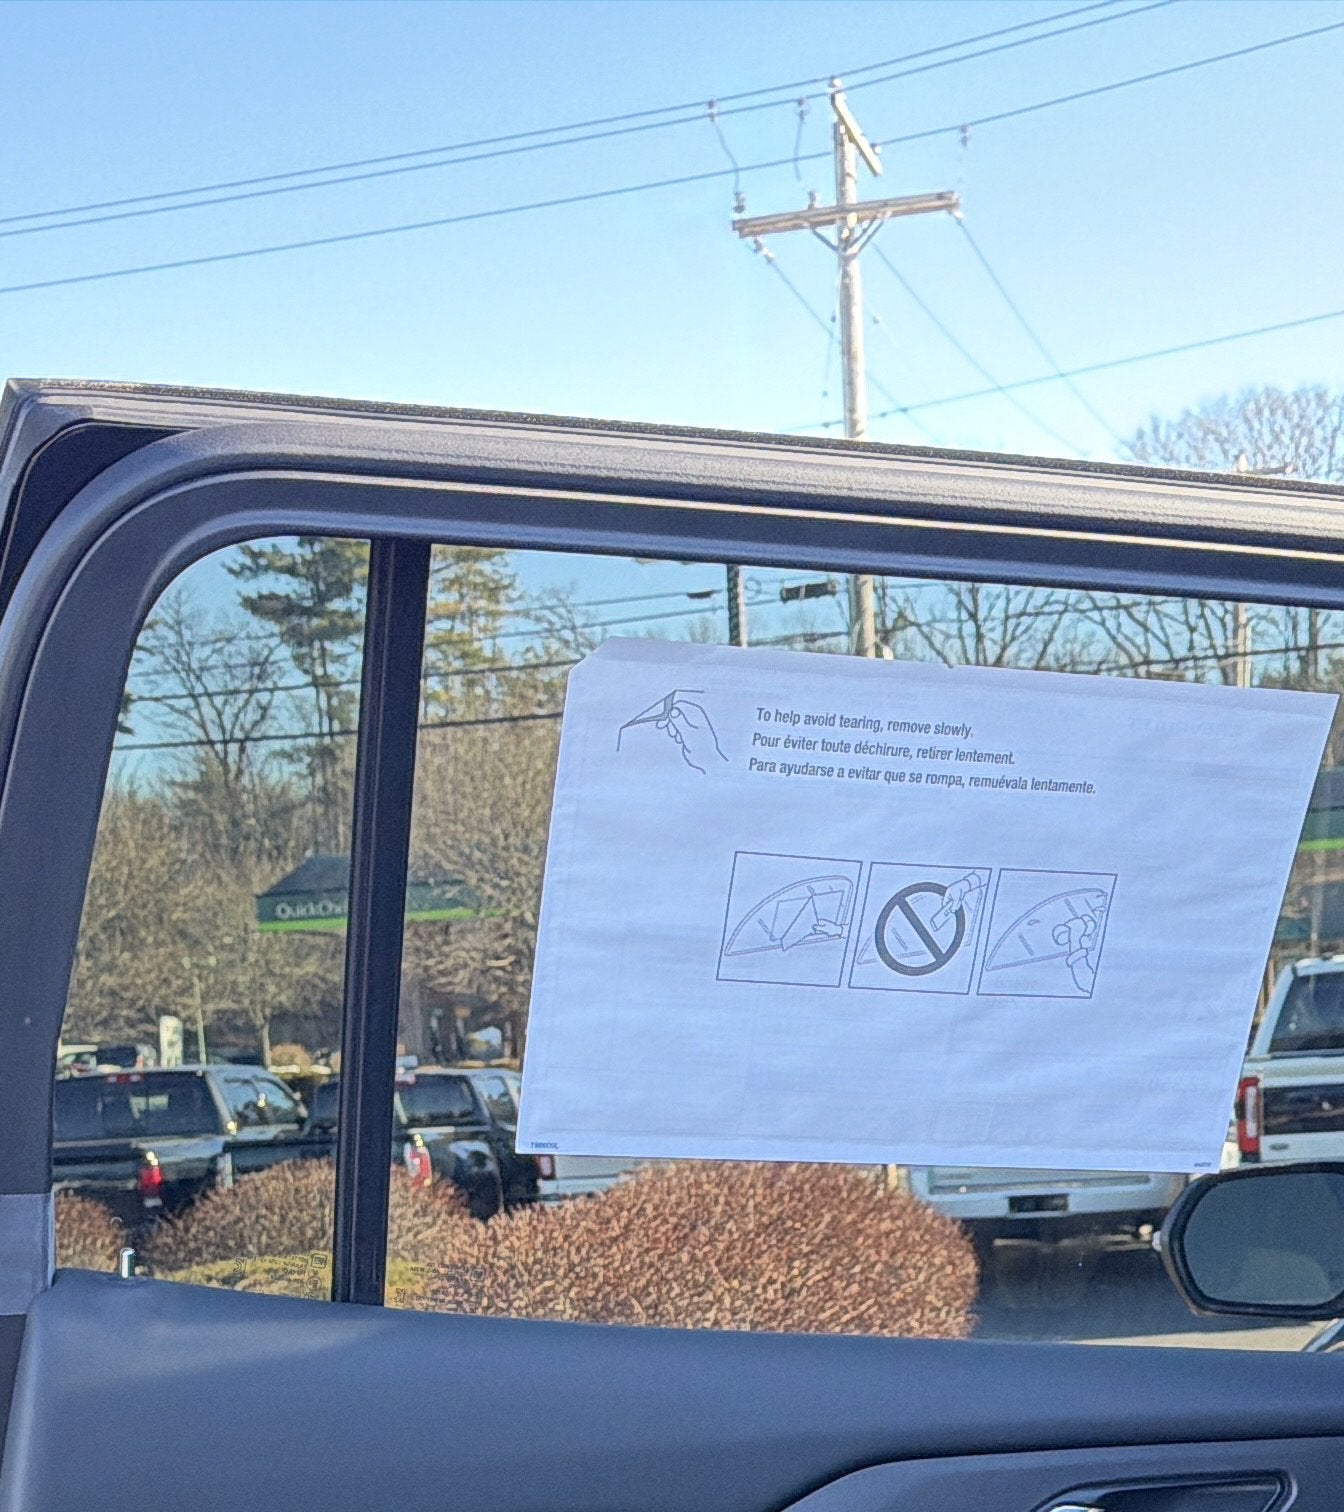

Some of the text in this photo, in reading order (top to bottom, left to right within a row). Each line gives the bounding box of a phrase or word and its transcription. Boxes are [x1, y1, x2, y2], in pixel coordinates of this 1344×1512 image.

[756, 707, 974, 740] To help avoid tearing, remove slowly.
[752, 732, 1016, 765] Pour éviter toute déchirure, retirer lentement.
[748, 756, 1097, 794] Para ayudarse a evitar que se rompa, remuévala lentamente.
